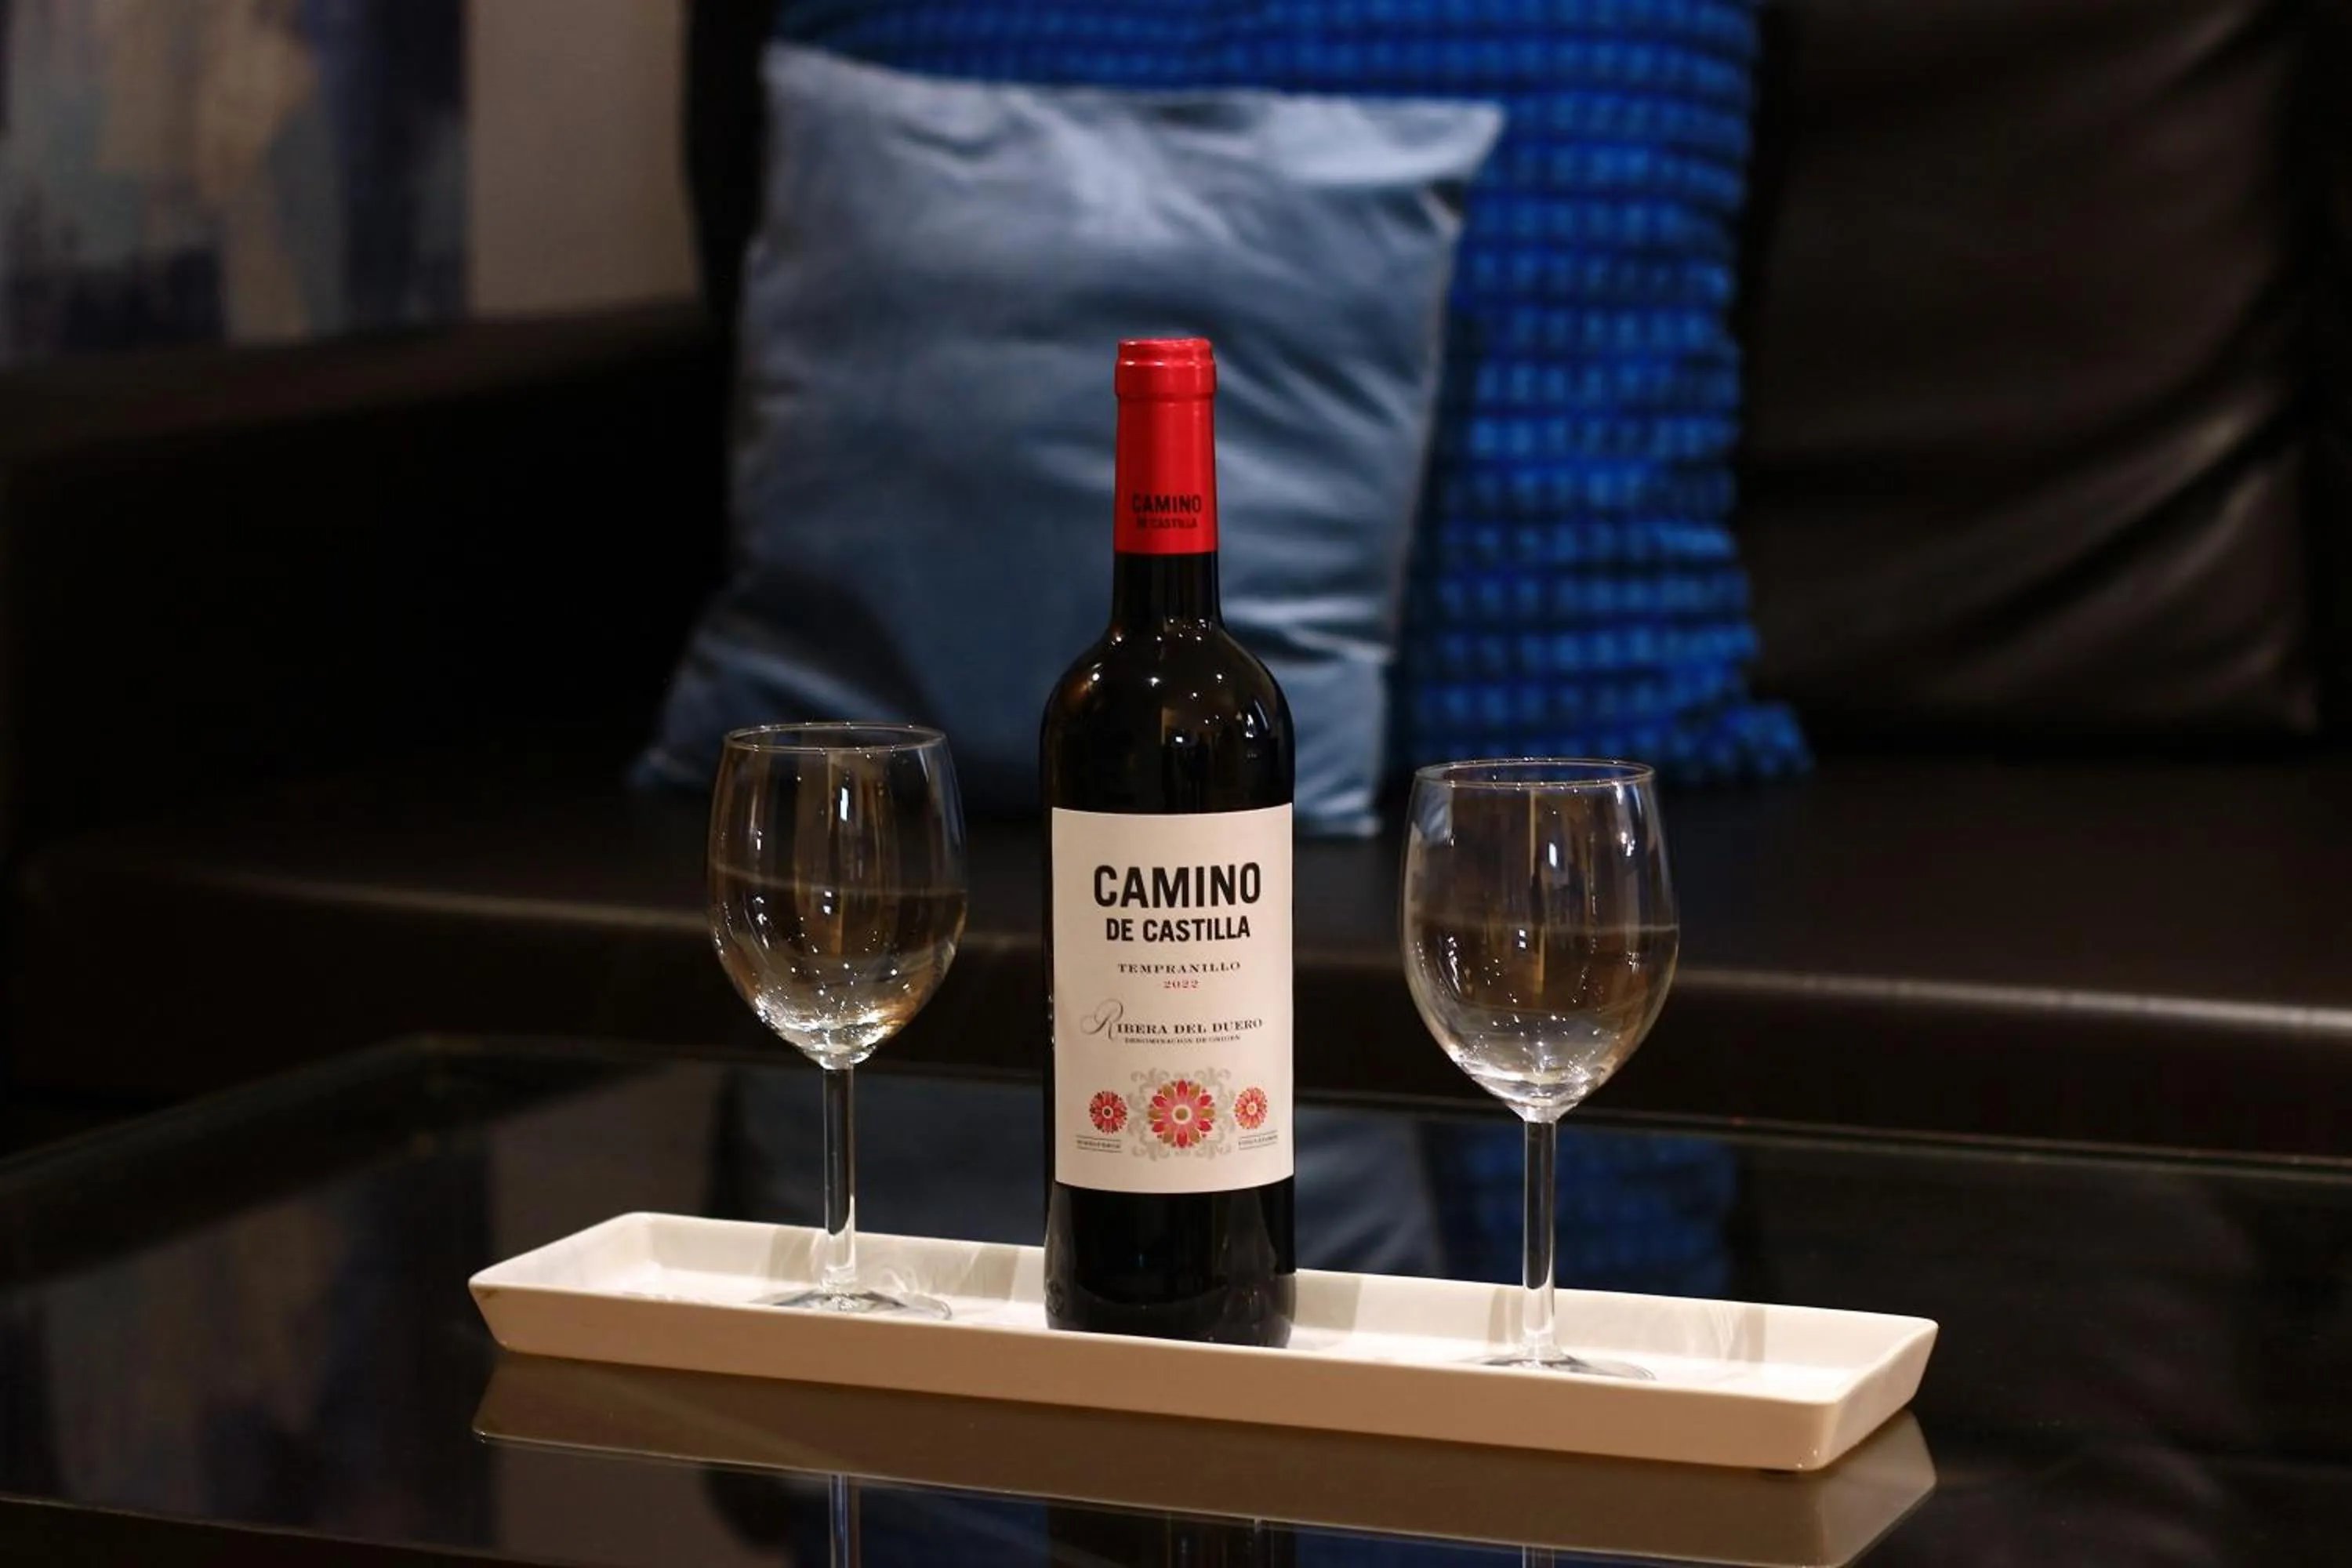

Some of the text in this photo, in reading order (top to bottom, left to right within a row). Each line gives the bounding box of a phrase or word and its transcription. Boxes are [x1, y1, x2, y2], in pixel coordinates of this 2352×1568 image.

[1132, 492, 1202, 514] CAMINO
[1094, 862, 1261, 908] CAMINO
[1106, 916, 1250, 942] DE CASTILLA
[1118, 962, 1241, 974] TEMPRANILLO
[1163, 980, 1200, 989] 2022
[1174, 1023, 1207, 1034] DEL
[1213, 1018, 1263, 1033] DUERO
